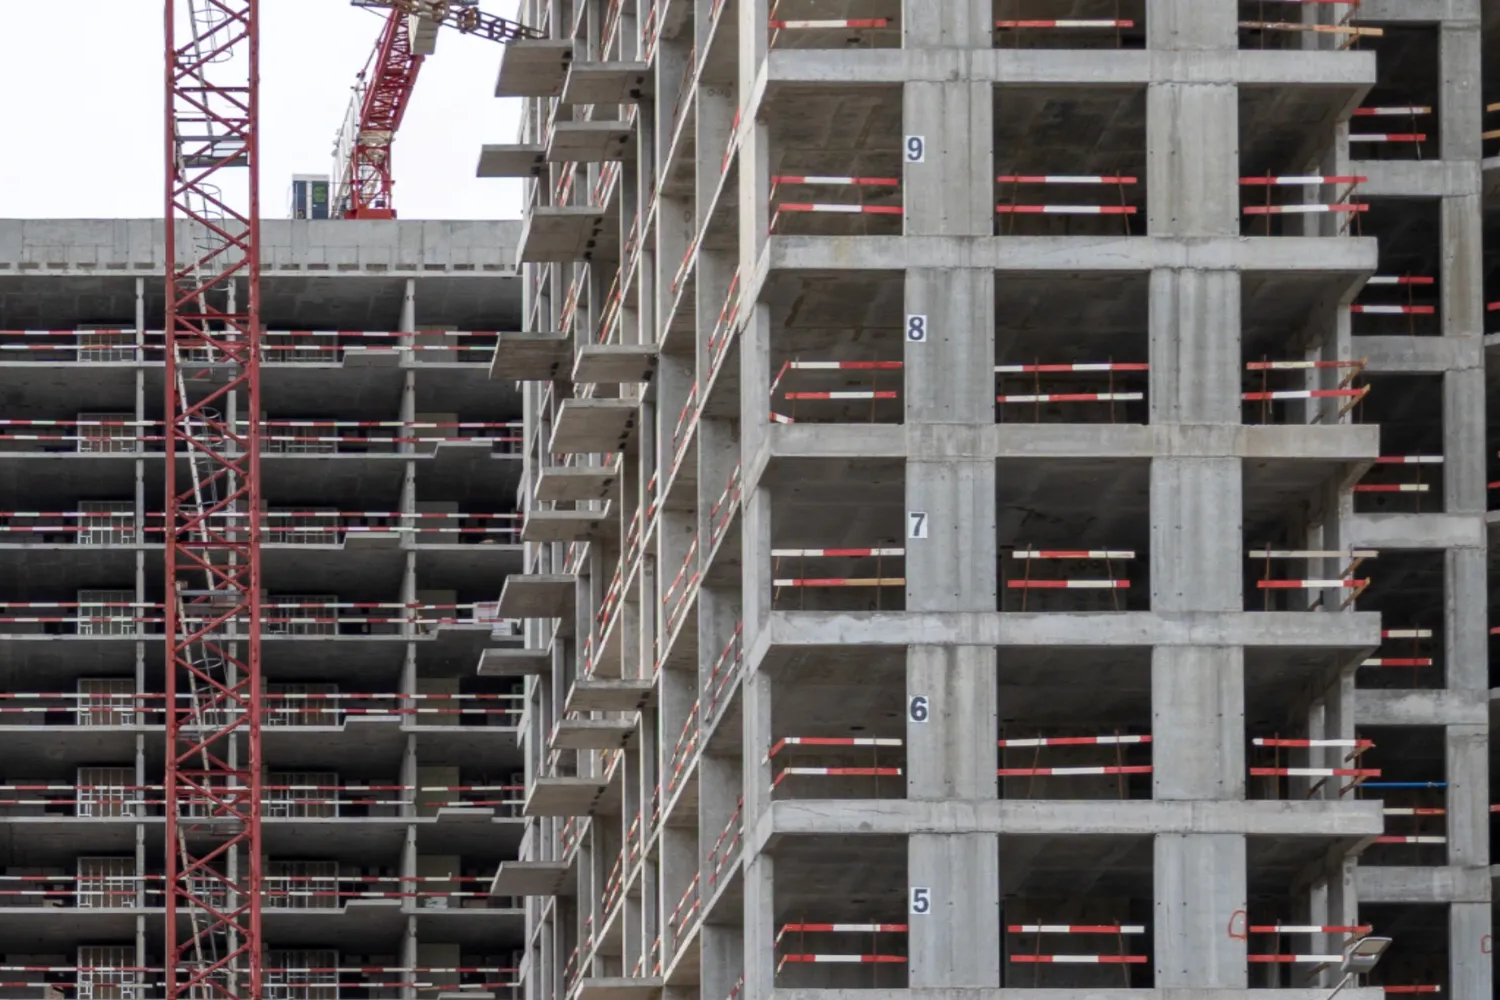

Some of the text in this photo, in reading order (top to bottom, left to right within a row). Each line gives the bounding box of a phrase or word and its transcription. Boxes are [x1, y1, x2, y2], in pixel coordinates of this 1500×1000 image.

[907, 137, 923, 161] 9
[908, 316, 924, 340] 8
[910, 513, 925, 536] 7
[910, 696, 927, 721] 6
[913, 889, 929, 913] 5
